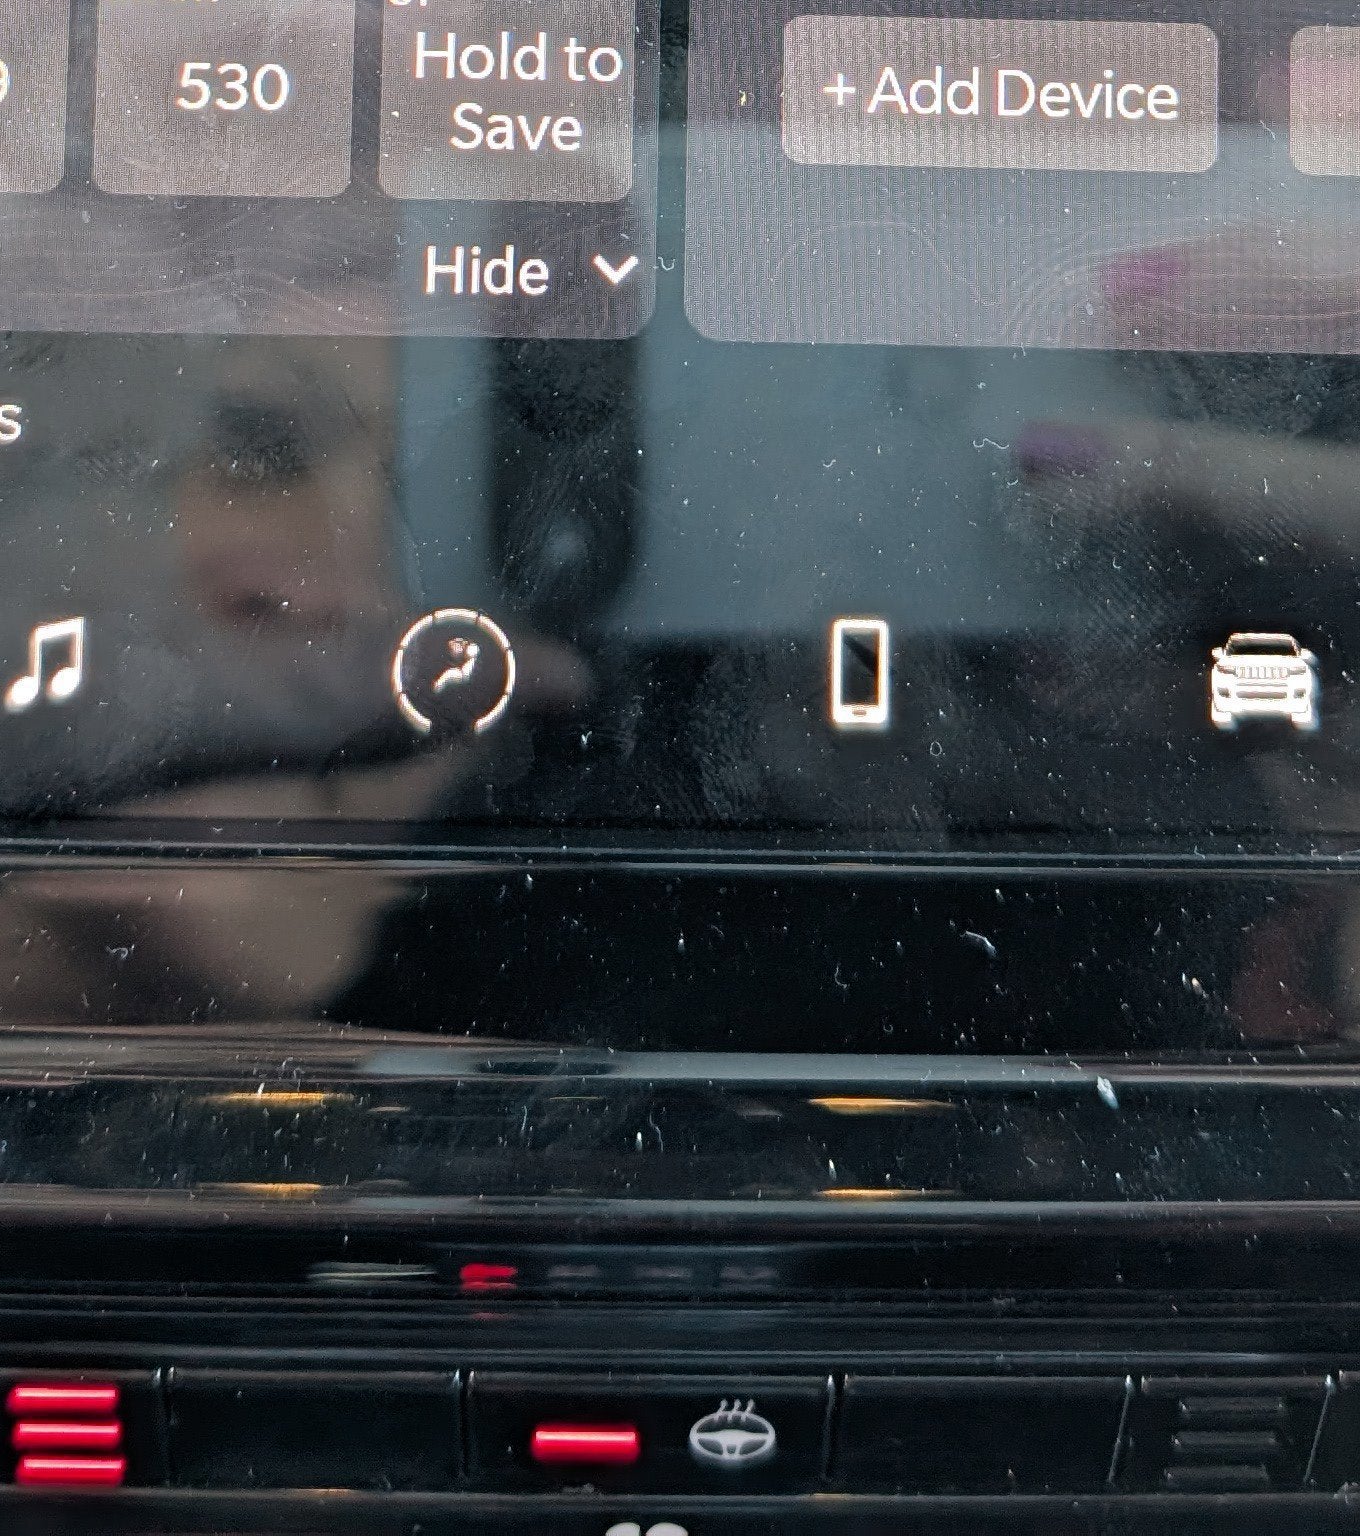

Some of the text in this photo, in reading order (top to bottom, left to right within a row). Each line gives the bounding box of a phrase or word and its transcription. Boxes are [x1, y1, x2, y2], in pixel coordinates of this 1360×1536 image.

[414, 31, 623, 84] Hold to
[176, 62, 290, 111] 530
[867, 66, 980, 116] Add
[996, 68, 1180, 122] Device
[452, 102, 583, 152] Save
[424, 246, 549, 296] Hide
